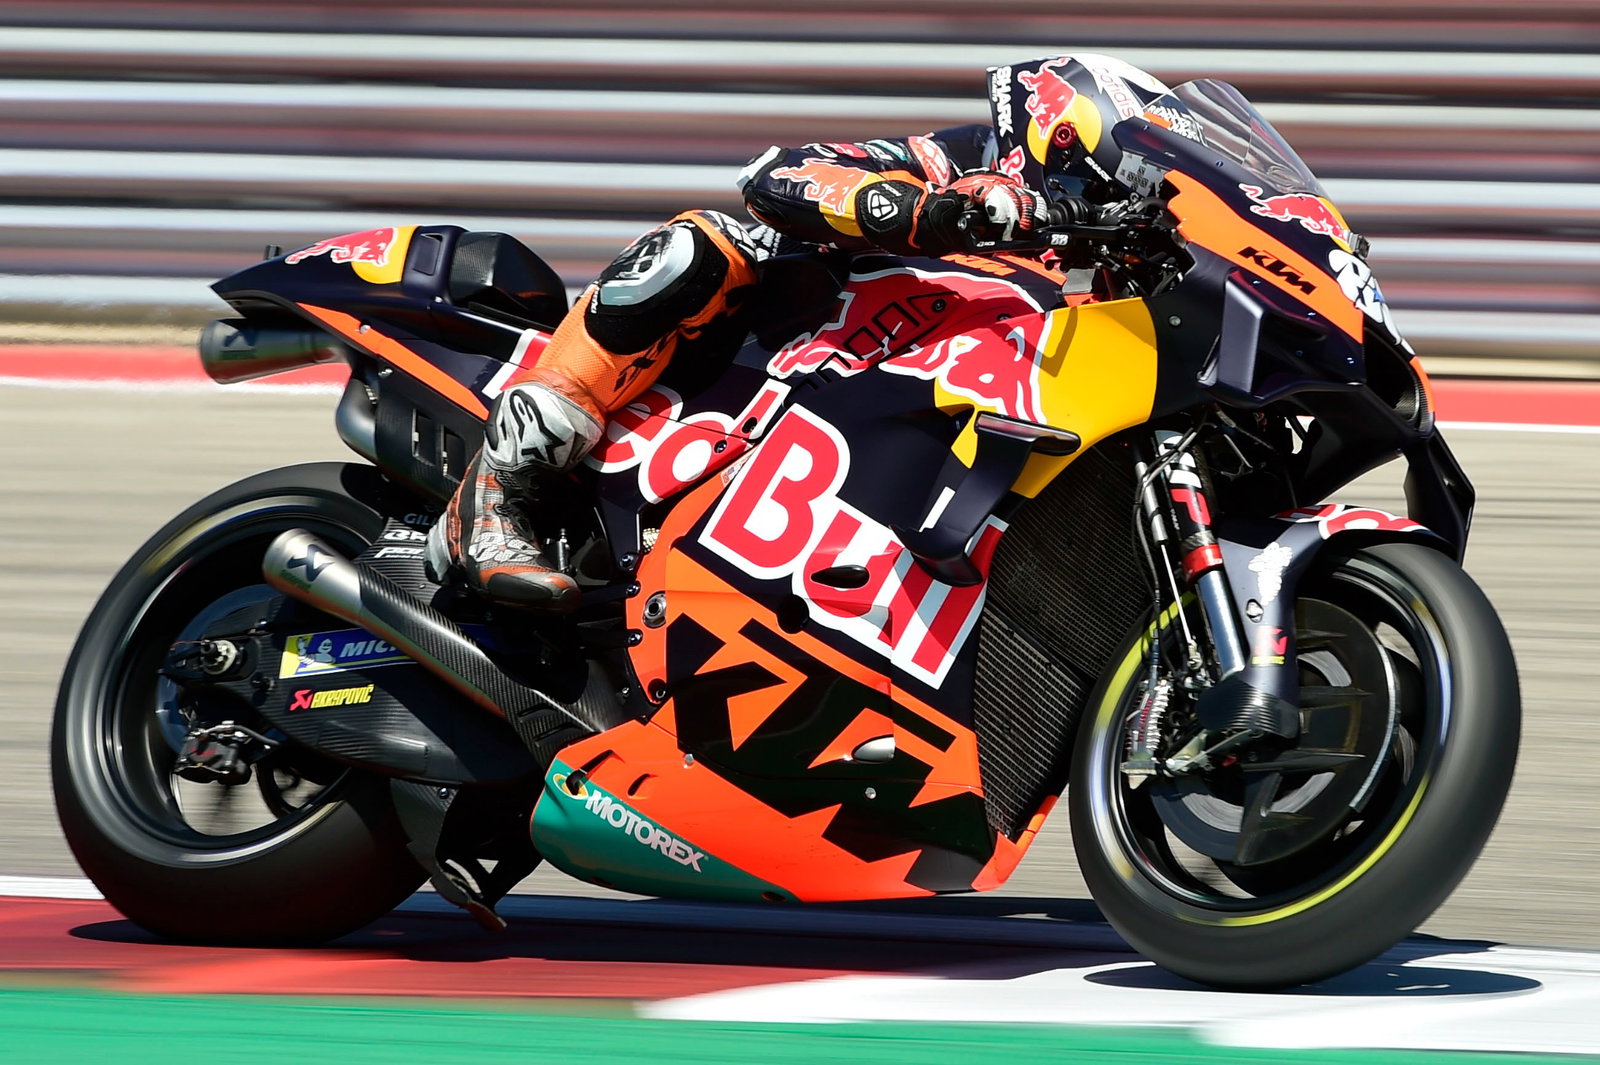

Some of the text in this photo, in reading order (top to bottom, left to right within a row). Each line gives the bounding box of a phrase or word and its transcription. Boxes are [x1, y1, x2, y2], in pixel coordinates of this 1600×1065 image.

[997, 65, 1014, 138] SHARK
[940, 253, 1017, 277] KTM
[1237, 246, 1317, 295] KTM
[697, 402, 1009, 690] Bull
[666, 612, 995, 893] KTM
[585, 789, 705, 873] MOTOREX
